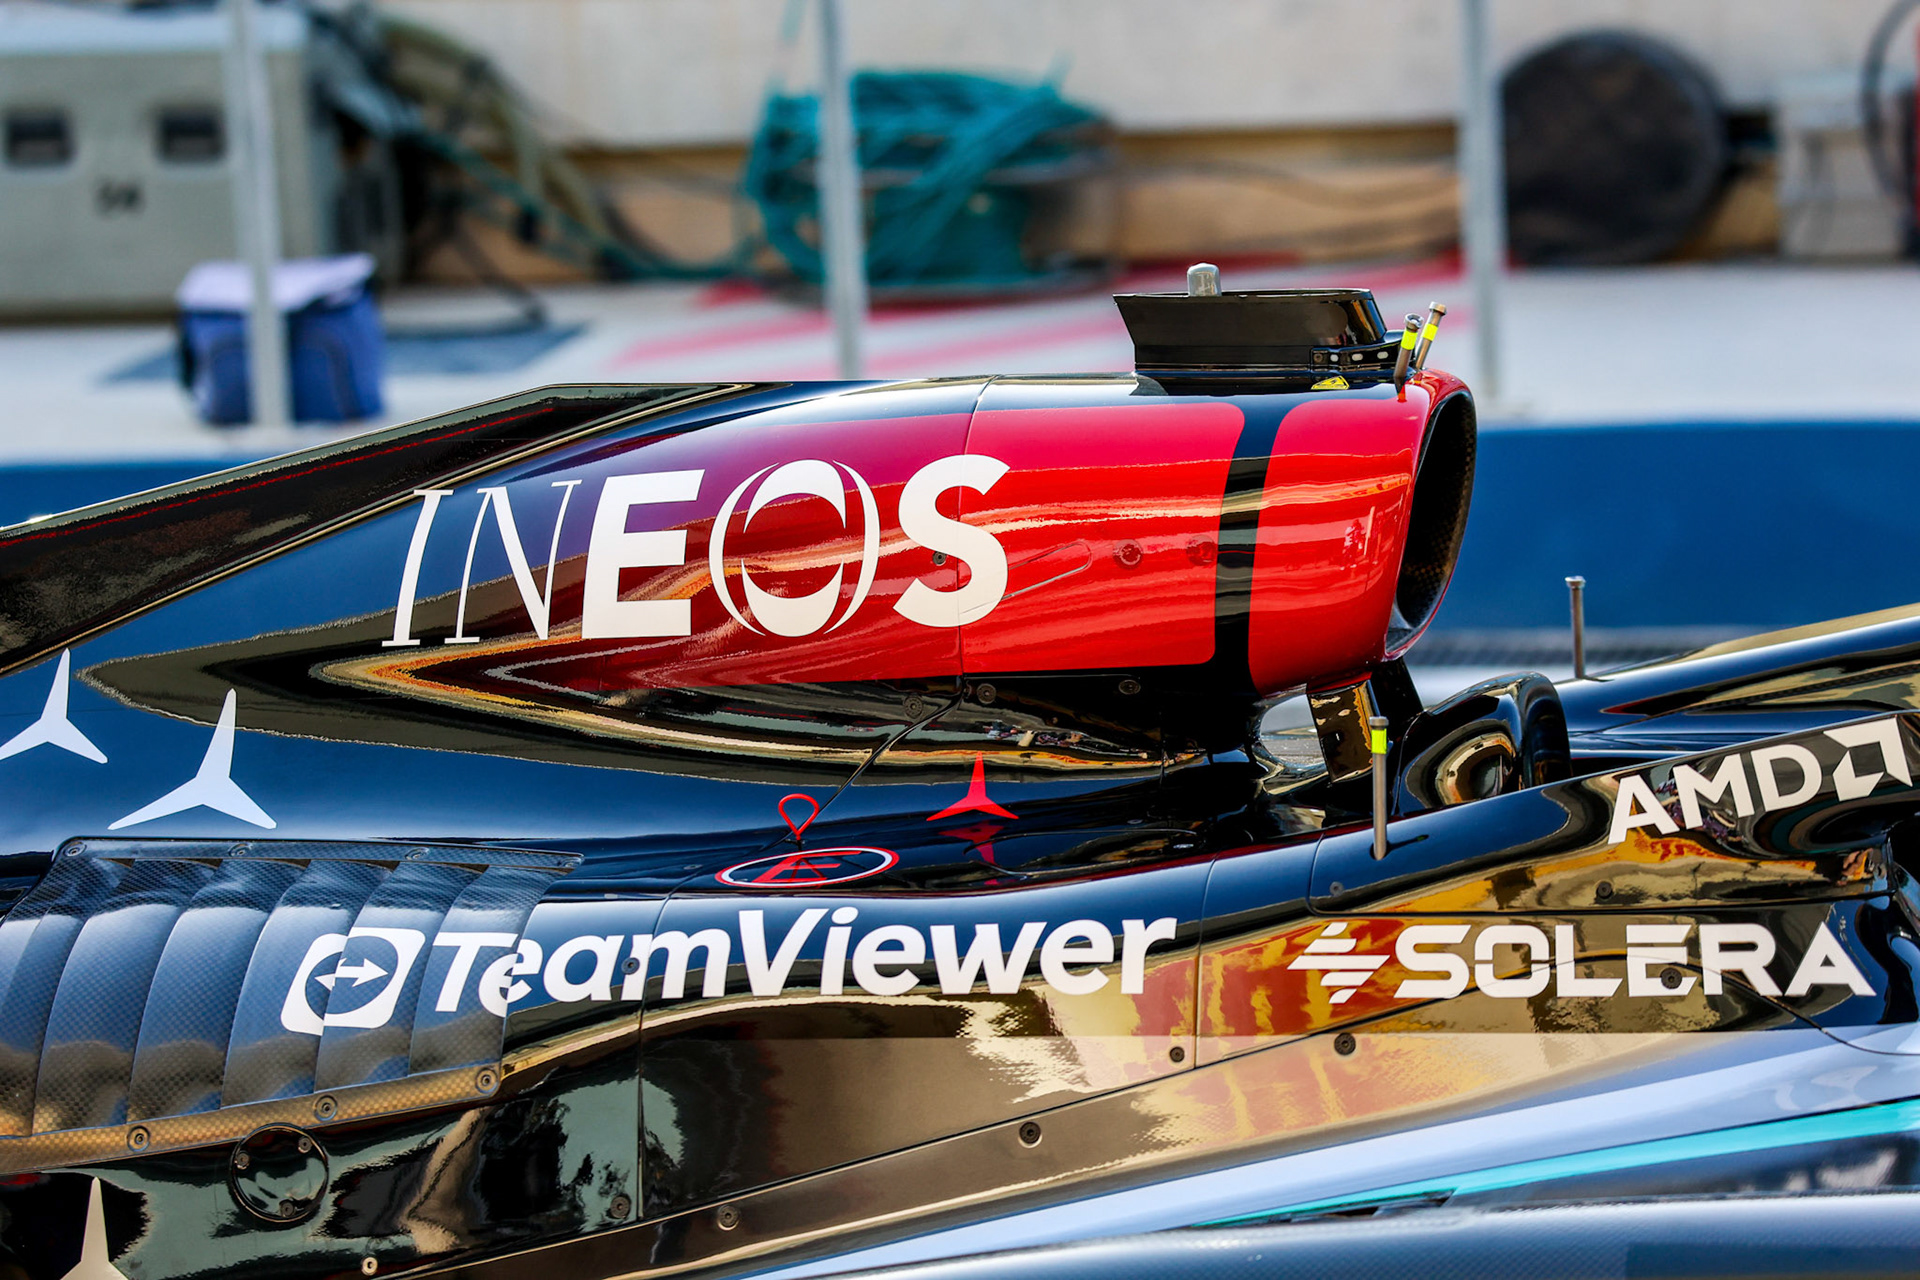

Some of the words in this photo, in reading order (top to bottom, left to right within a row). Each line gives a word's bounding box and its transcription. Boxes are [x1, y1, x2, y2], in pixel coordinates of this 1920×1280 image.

[382, 454, 1010, 646] INEOS
[1607, 743, 1823, 844] AMD
[432, 905, 1177, 1016] TeamViewer
[1393, 921, 1877, 999] SOLERA
